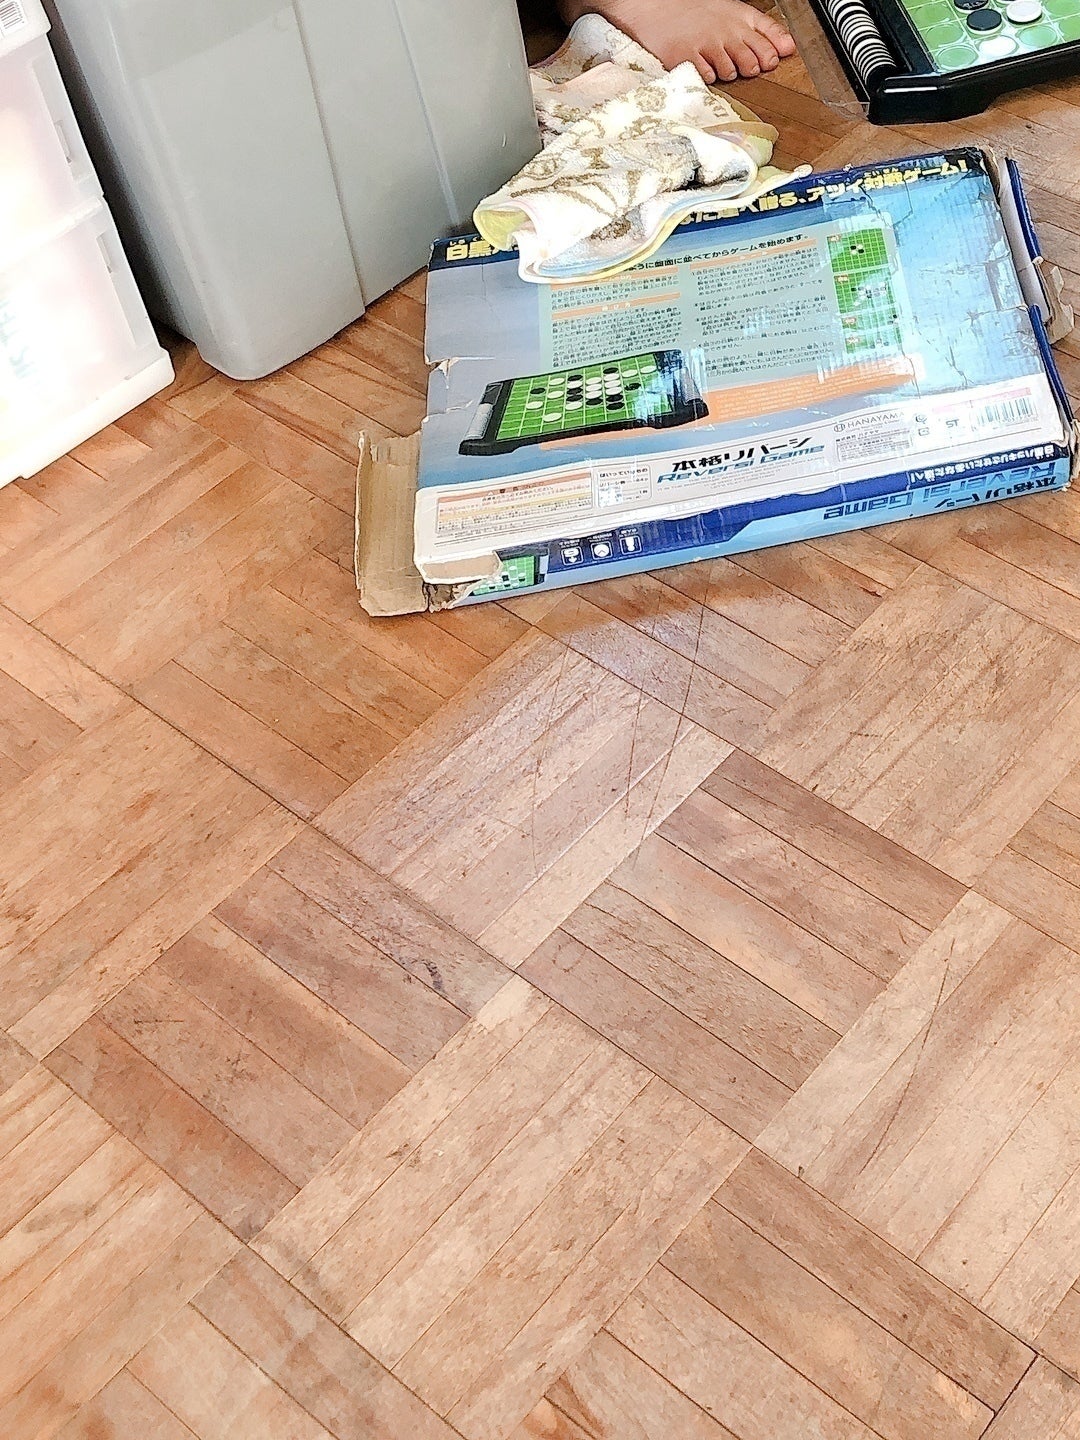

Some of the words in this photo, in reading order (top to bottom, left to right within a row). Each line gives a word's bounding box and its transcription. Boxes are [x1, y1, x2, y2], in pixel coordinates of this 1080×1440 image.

[847, 411, 905, 428] HANAYAMA
[656, 456, 755, 484] Reversi
[759, 444, 826, 464] Game
[672, 436, 813, 473] 本格リバーシ
[924, 461, 1057, 500] Reversi
[935, 477, 1057, 509] 本格リバーシ
[822, 492, 914, 521] Game
